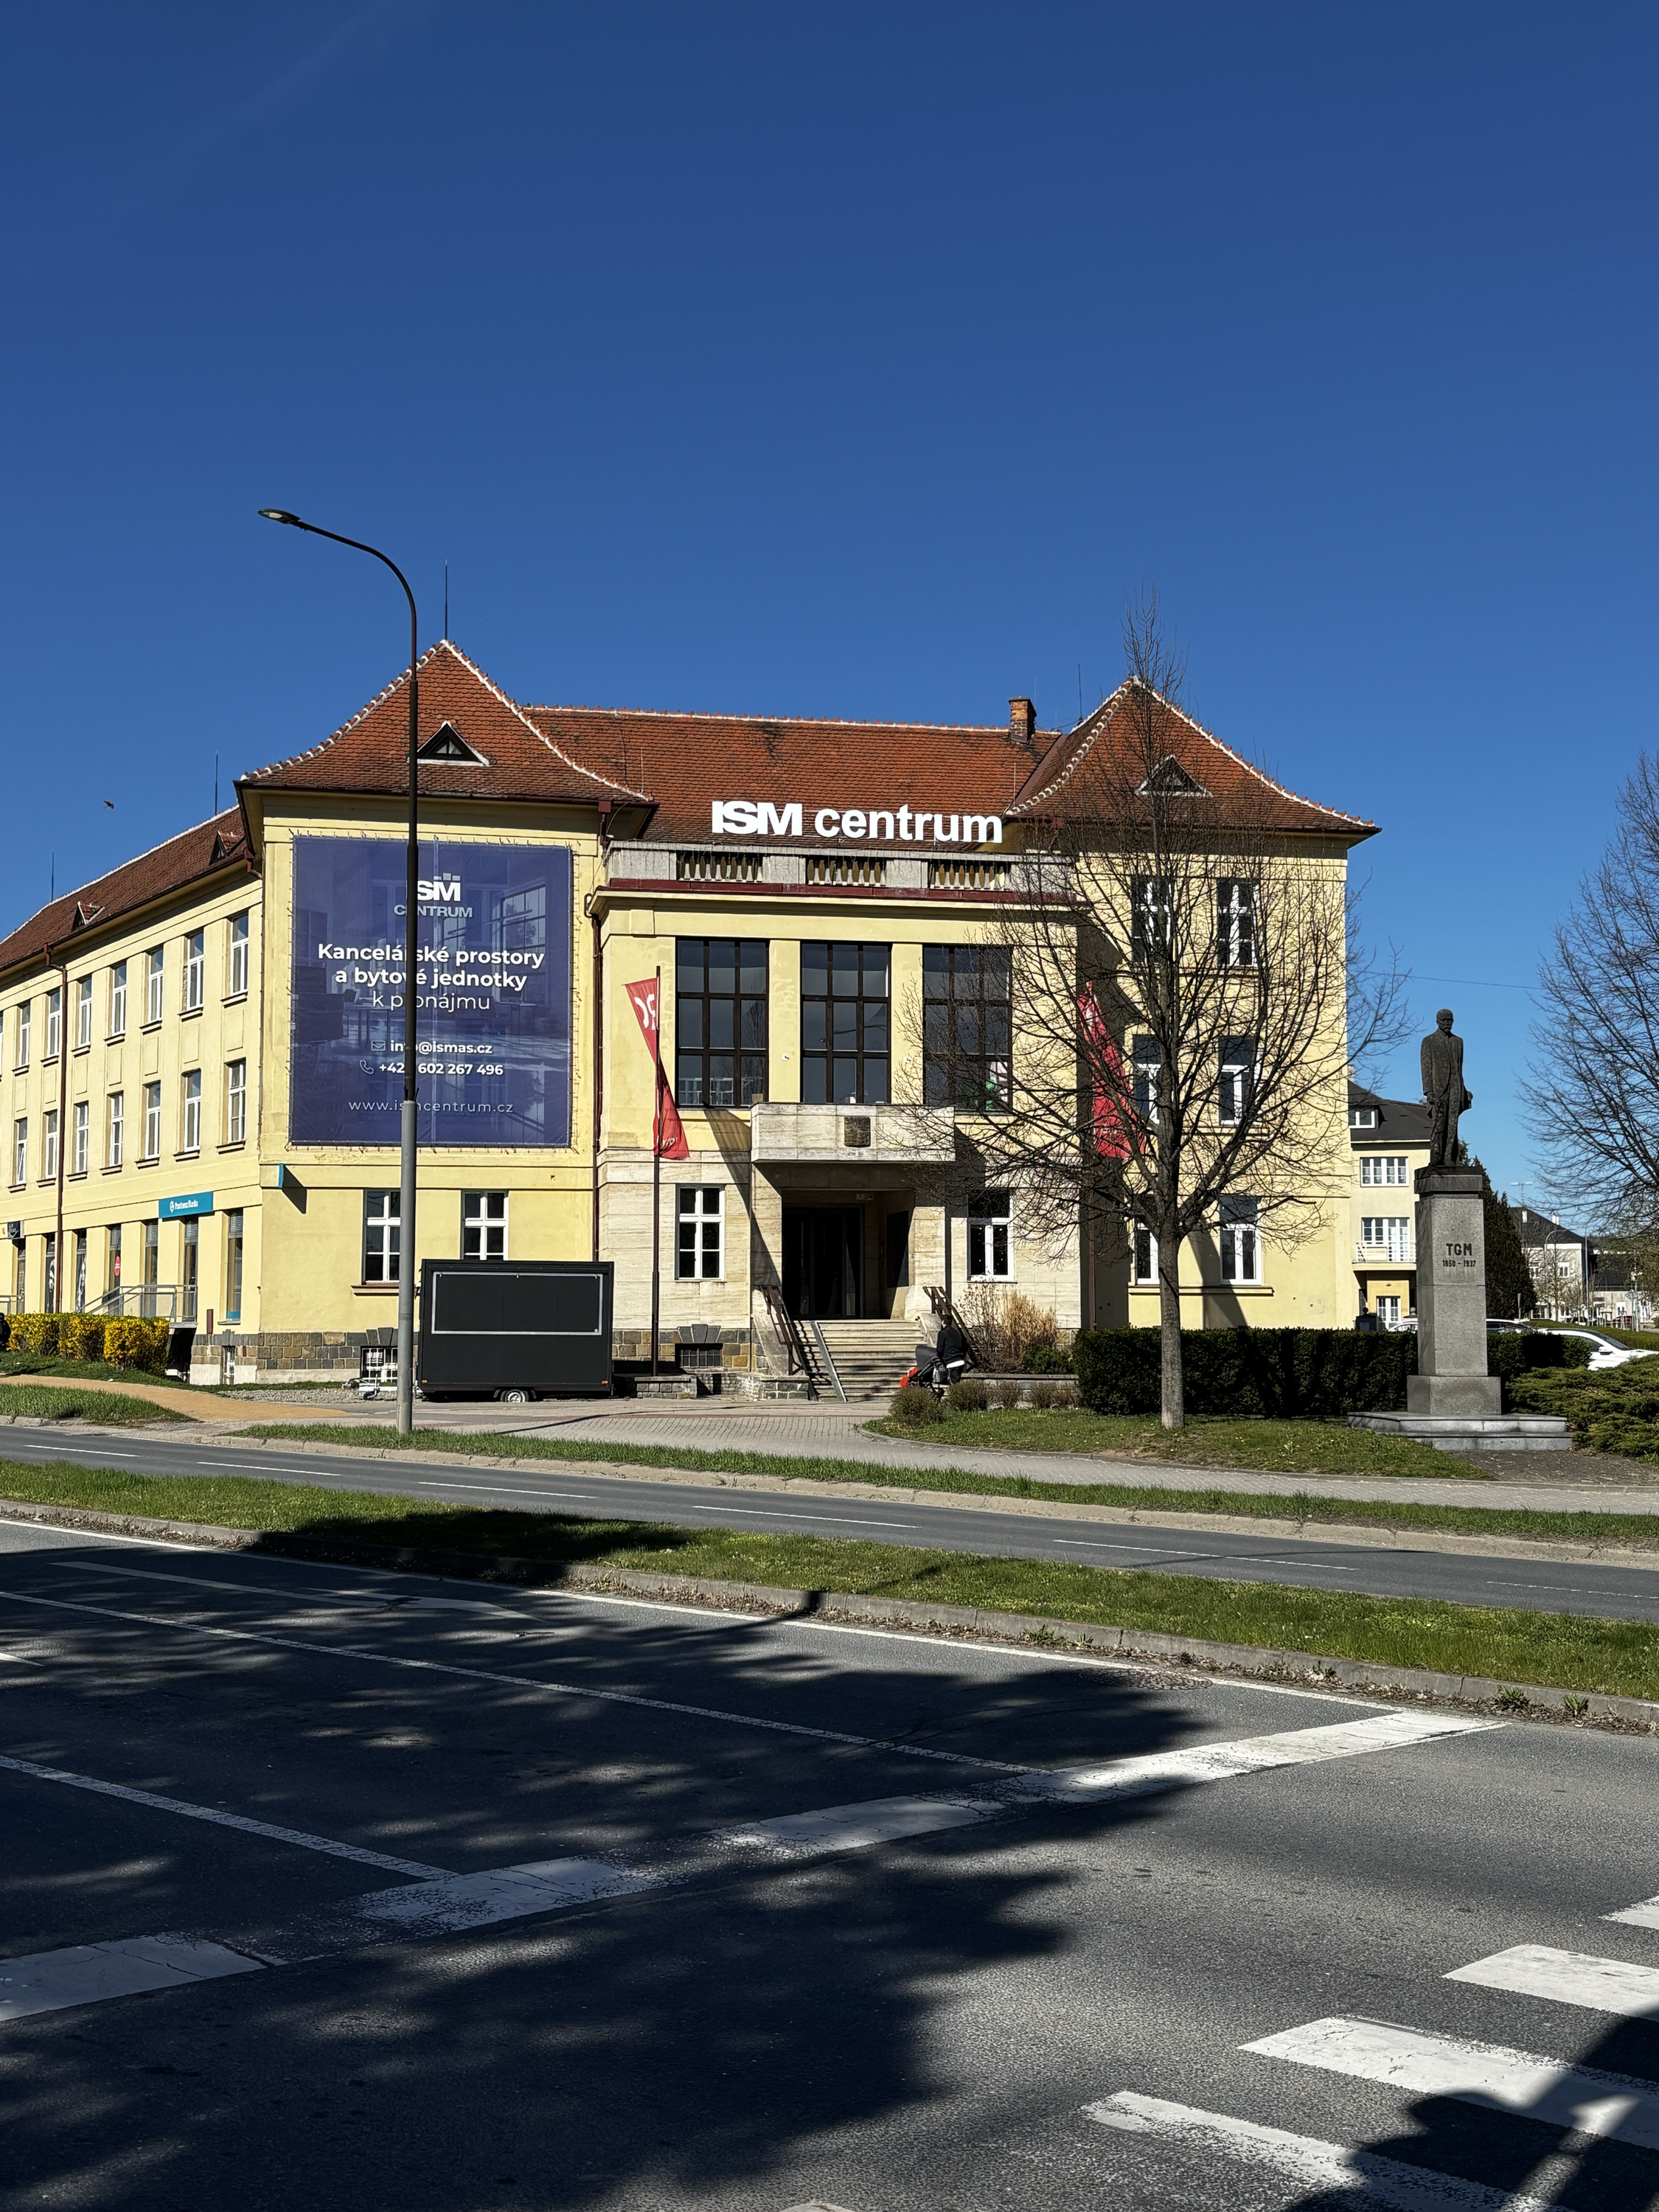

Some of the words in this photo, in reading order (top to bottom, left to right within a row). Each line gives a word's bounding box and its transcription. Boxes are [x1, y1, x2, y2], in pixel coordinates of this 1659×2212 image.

[712, 800, 802, 836] ISM
[815, 804, 1003, 844] centrum
[406, 880, 461, 902] SM
[393, 904, 473, 918] CNTRUM
[318, 943, 450, 962] Kanceláské
[456, 950, 545, 969] prostory
[335, 970, 347, 983] a
[431, 968, 527, 991] jednotky
[372, 990, 384, 1007] k
[391, 992, 490, 1012] ponájmu
[390, 1040, 493, 1055] in@ismas.cz
[379, 1062, 406, 1074] +42
[418, 1063, 445, 1074] 602
[448, 1063, 473, 1075] 267
[476, 1064, 504, 1075] 496
[1446, 1243, 1472, 1256] TGM
